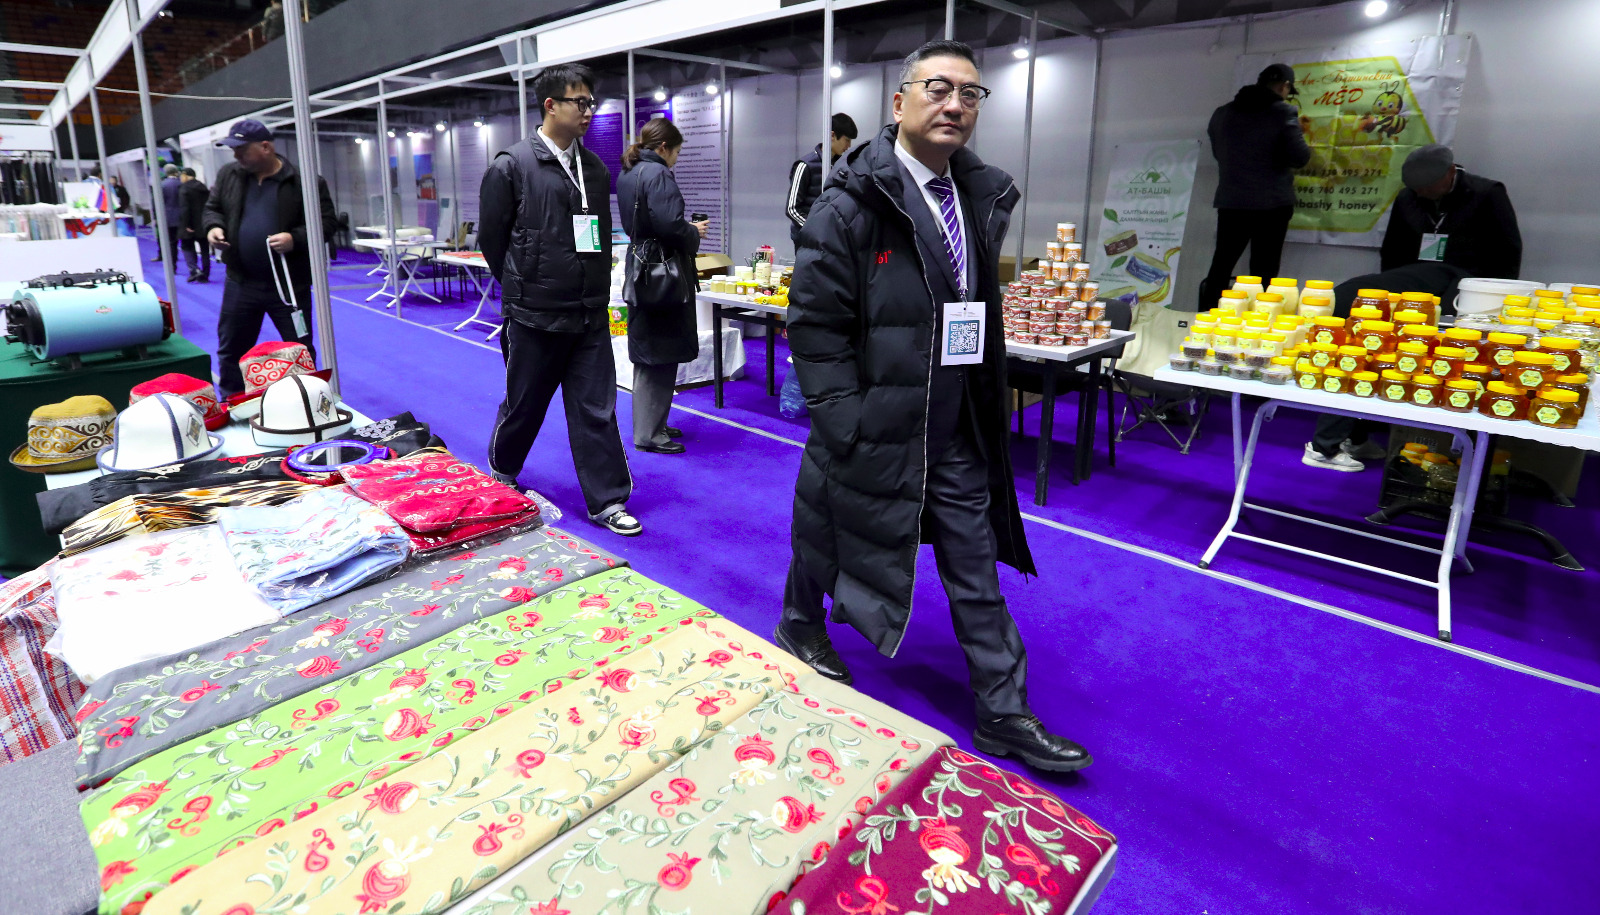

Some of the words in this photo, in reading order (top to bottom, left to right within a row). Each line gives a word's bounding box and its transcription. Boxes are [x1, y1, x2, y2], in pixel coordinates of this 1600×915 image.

[1313, 85, 1364, 105] МЁД
[1297, 186, 1314, 194] 996
[1339, 187, 1356, 195] 495
[1361, 187, 1379, 195] 271
